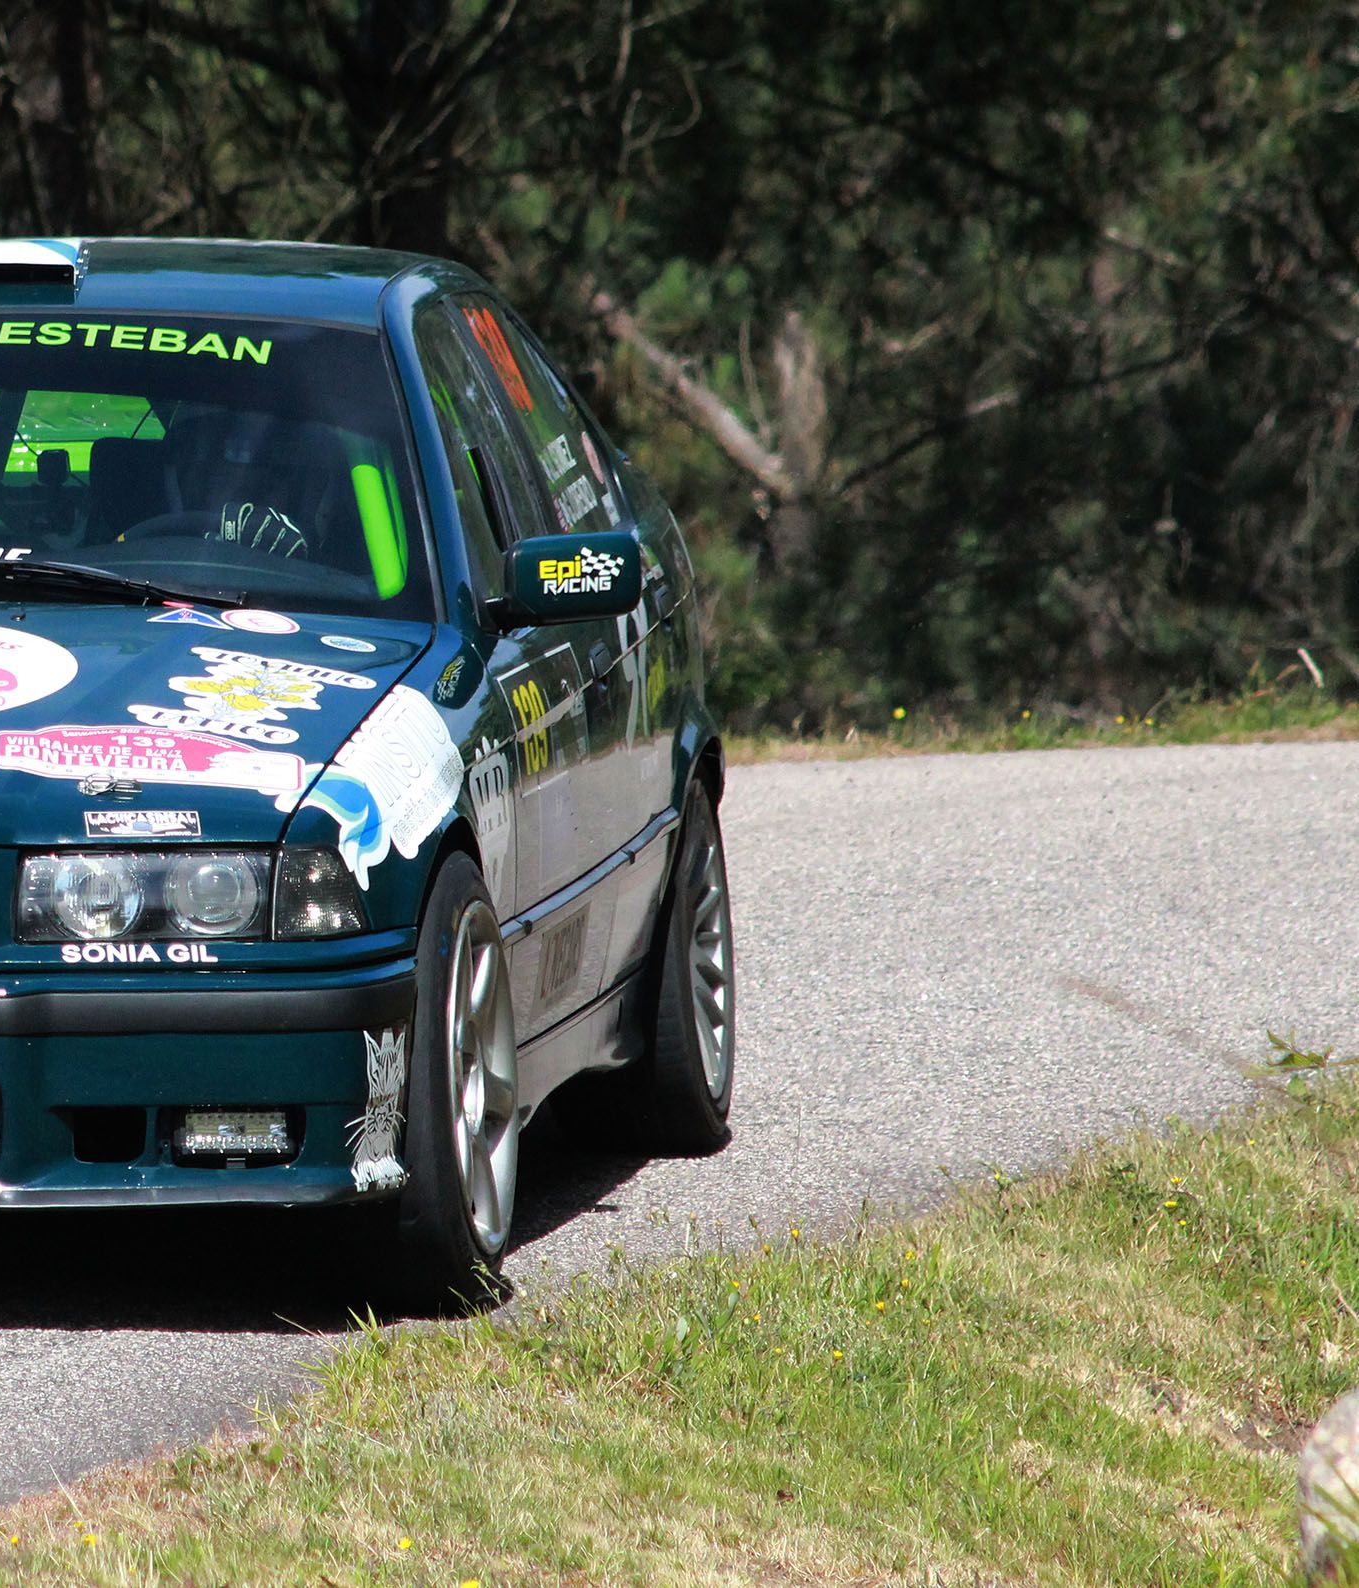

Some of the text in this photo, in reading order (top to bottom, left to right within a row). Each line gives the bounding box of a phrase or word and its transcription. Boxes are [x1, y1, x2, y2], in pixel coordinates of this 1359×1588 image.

[538, 555, 582, 584] Epi
[544, 576, 612, 596] RACING
[6, 736, 36, 747] VIII
[39, 737, 104, 755] RALLYE
[109, 746, 132, 757] DE
[110, 734, 177, 749] 139
[5, 744, 189, 771] PONTEVEDRA
[61, 943, 219, 963] SONIA GIL
